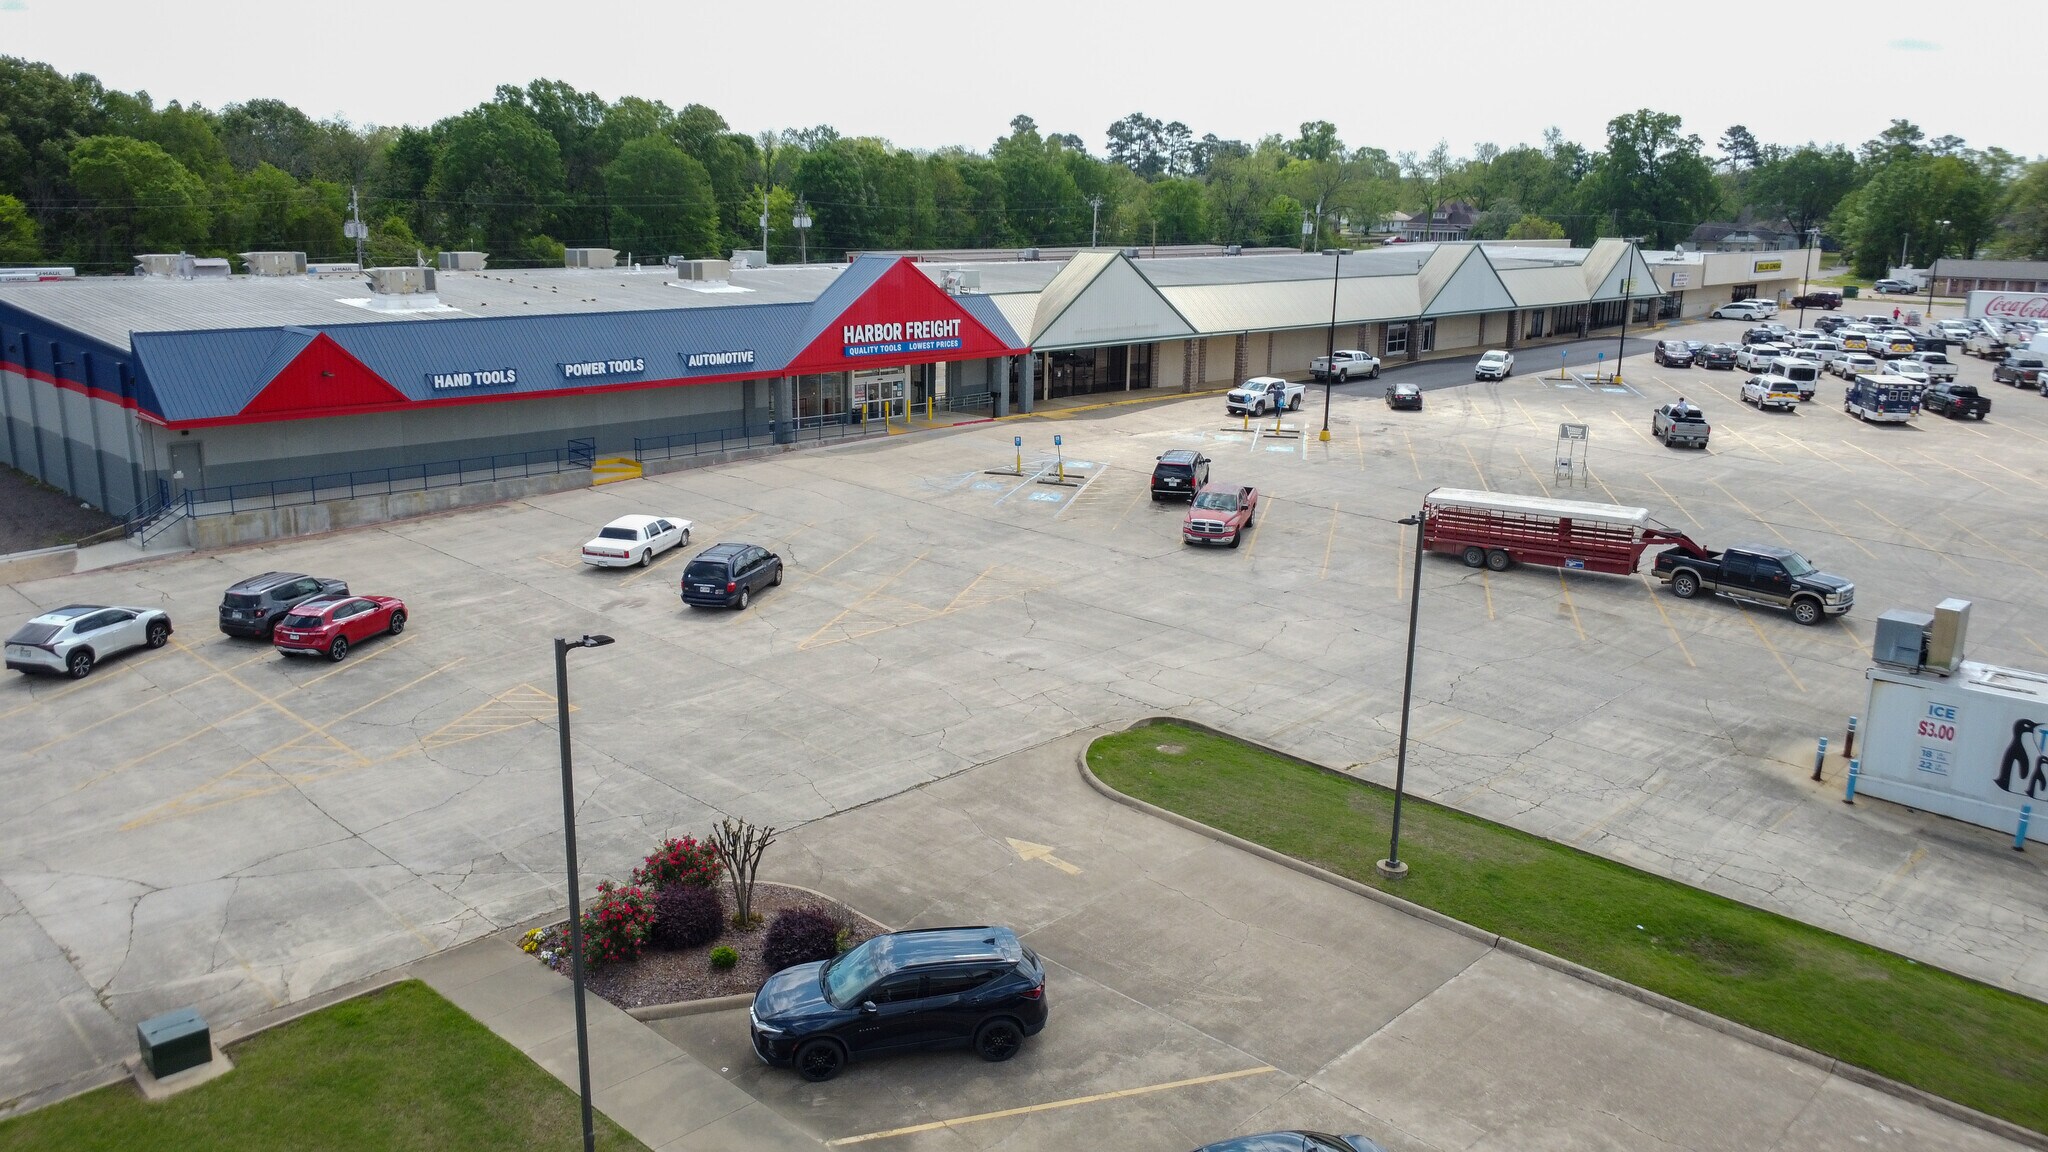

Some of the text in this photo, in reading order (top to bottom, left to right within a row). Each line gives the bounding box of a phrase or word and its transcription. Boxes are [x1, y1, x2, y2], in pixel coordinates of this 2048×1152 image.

[843, 319, 961, 344] HARBOR FREIGHT
[849, 340, 959, 355] QUALITY TOOLS LOWEST PRICES
[688, 350, 754, 367] AUTOMOTIVE
[565, 358, 645, 377] POWER TOOLS
[434, 369, 516, 388] HAND TOOLS
[1928, 704, 1956, 720] ICE
[1917, 720, 1955, 741] $3.00
[1921, 749, 1933, 758] 18
[1919, 760, 1932, 769] 22
